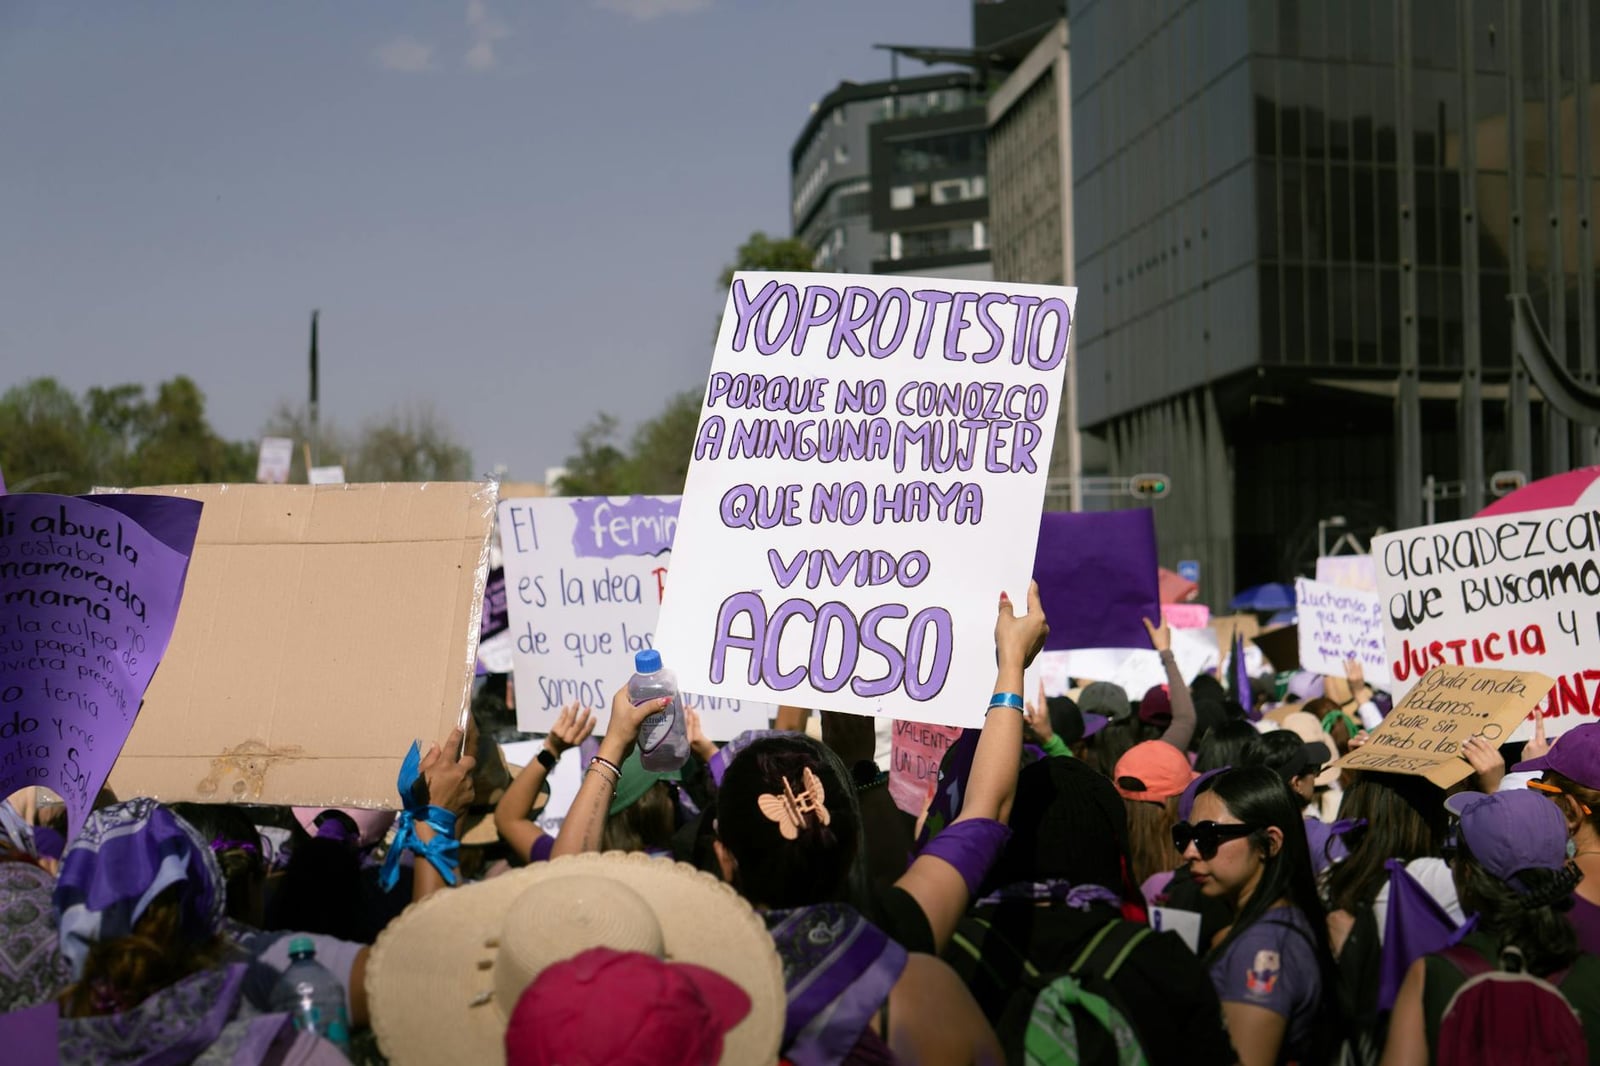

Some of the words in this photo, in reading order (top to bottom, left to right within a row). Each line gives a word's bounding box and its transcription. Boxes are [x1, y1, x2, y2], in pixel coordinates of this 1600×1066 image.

[707, 372, 829, 414] PORQUE
[835, 379, 887, 415] NO
[896, 381, 1048, 421] CONOZCO
[695, 415, 726, 461] A
[727, 417, 891, 463] NINGUNA
[893, 419, 1042, 473] MUJER
[720, 484, 802, 530] QUE
[810, 481, 867, 526] NO
[873, 480, 984, 525] HAYA
[21, 534, 104, 566] estaba
[30, 504, 138, 568] abuela
[510, 506, 539, 553] El
[518, 575, 547, 608] es
[560, 568, 585, 606] la
[593, 567, 642, 605] idea
[767, 549, 931, 589] VIVIDO
[4, 588, 111, 624] mamá
[17, 614, 41, 632] la
[51, 618, 117, 649] culpa
[35, 639, 86, 657] papá
[517, 621, 550, 655] de
[564, 631, 612, 667] que
[709, 591, 953, 701] ACOSO
[41, 677, 99, 719] tenía
[1418, 739, 1432, 751] a
